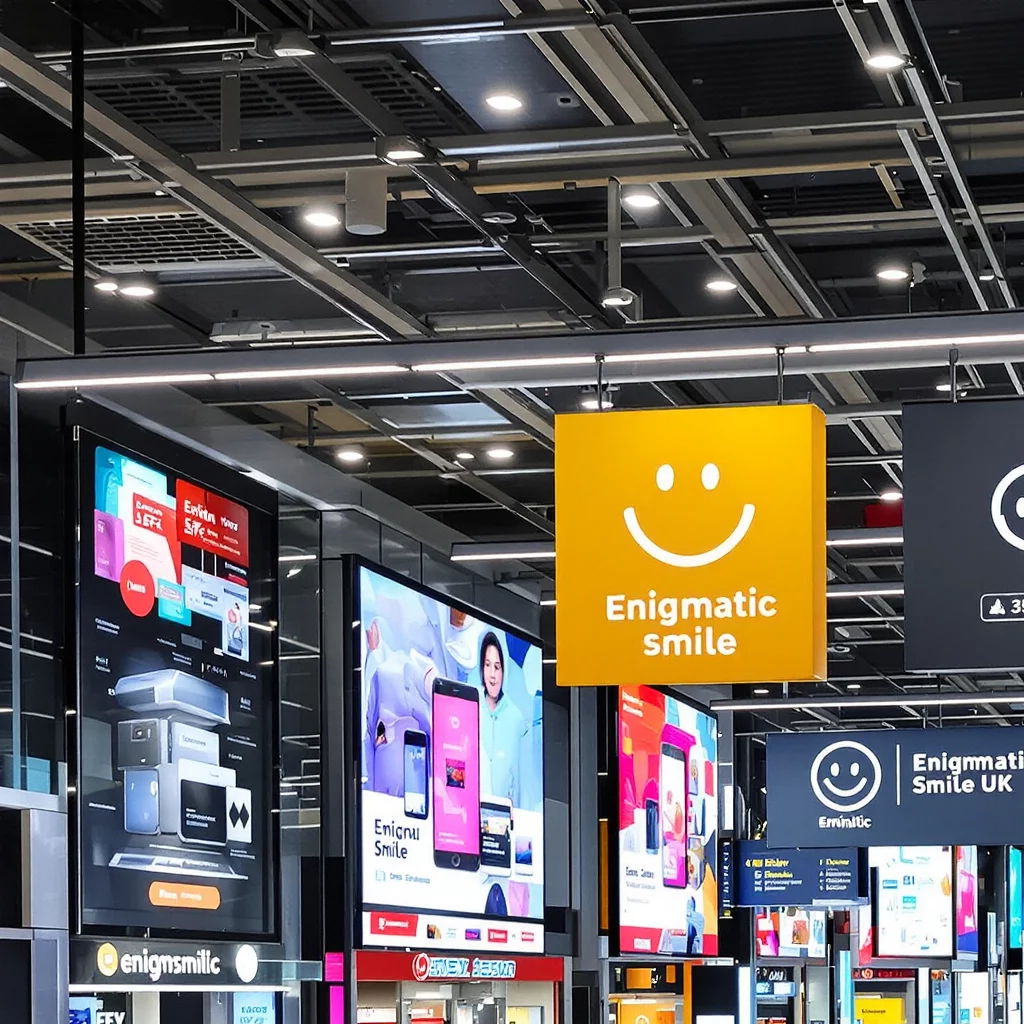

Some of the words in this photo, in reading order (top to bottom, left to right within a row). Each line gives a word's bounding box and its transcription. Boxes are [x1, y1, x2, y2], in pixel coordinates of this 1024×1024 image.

[606, 586, 777, 627] Enigmatic
[643, 625, 737, 656] smile
[912, 774, 976, 794] Smile
[981, 773, 1013, 793] UK
[375, 840, 408, 859] Smile
